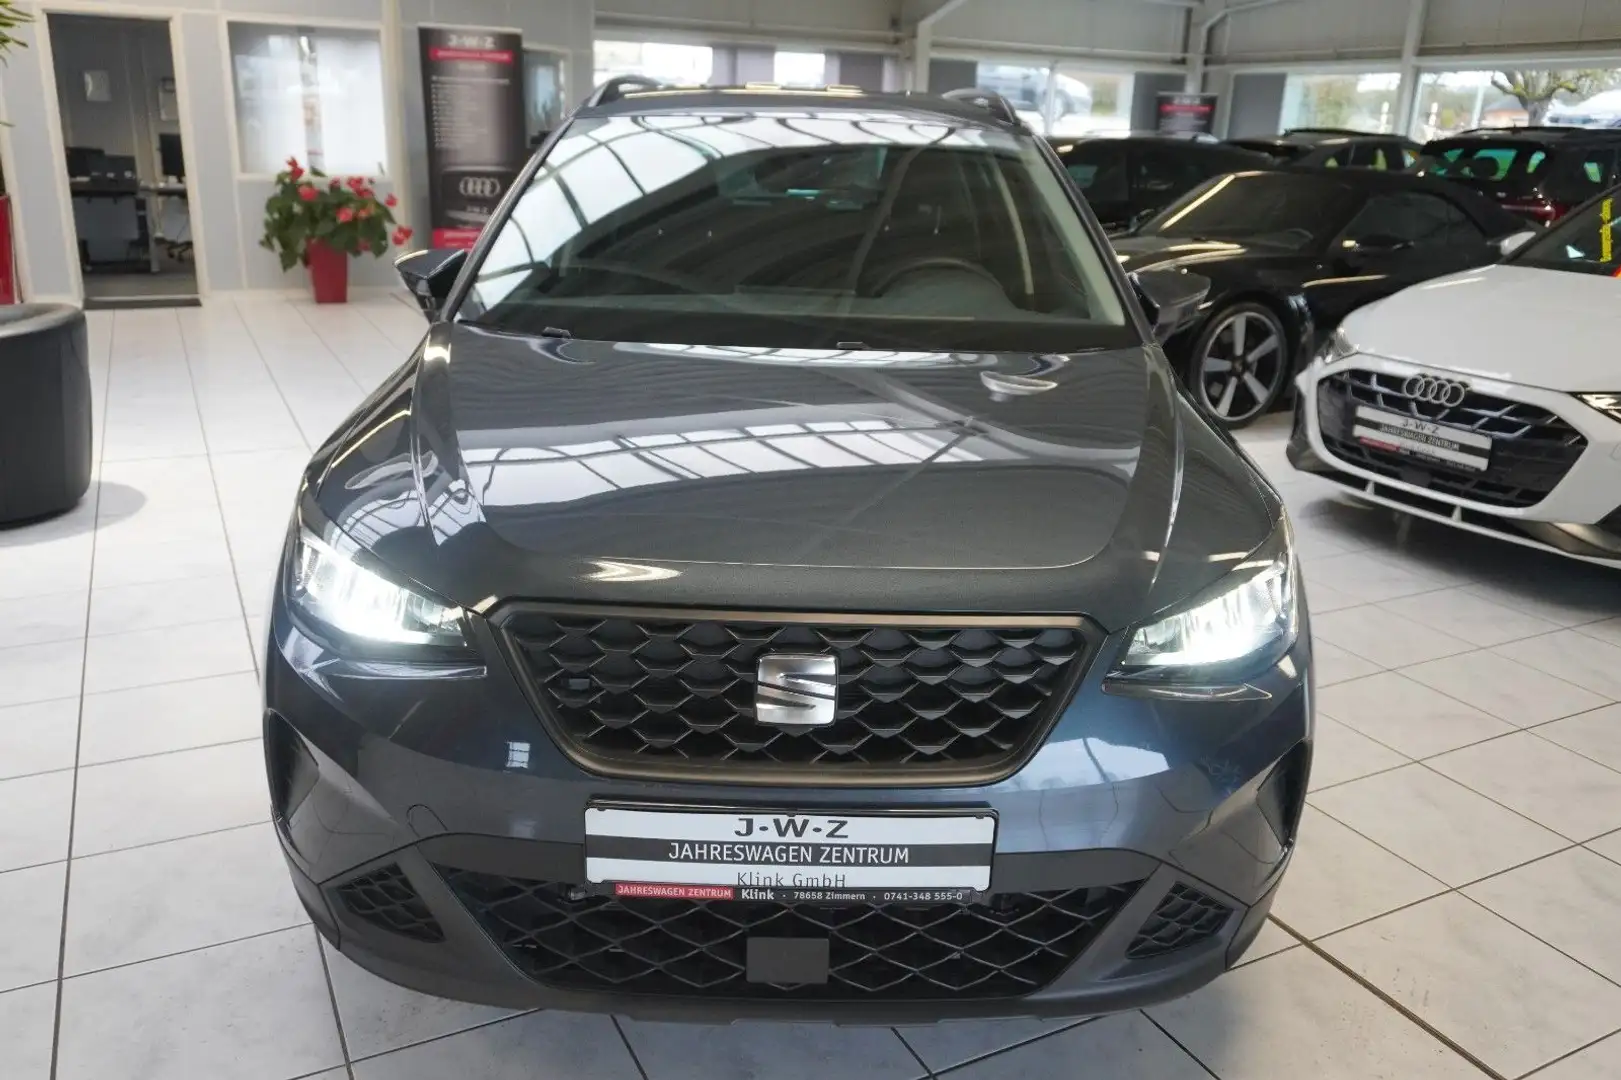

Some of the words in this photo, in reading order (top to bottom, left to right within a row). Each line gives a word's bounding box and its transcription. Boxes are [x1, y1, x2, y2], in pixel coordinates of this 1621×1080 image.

[1427, 435, 1460, 451] ZENTRUM
[668, 842, 812, 863] JAHRESWAGEN
[818, 846, 909, 864] ZENTRUM
[737, 871, 785, 887] Klink
[792, 873, 846, 888] GmbH
[617, 885, 685, 897] JAHRESWAGEN
[687, 887, 732, 898] ZENTRUM
[741, 888, 775, 900] Klink
[793, 891, 823, 900] 78658
[825, 891, 866, 901] Zimmern
[884, 892, 931, 901] 0741-348
[934, 892, 963, 901] 555-0
